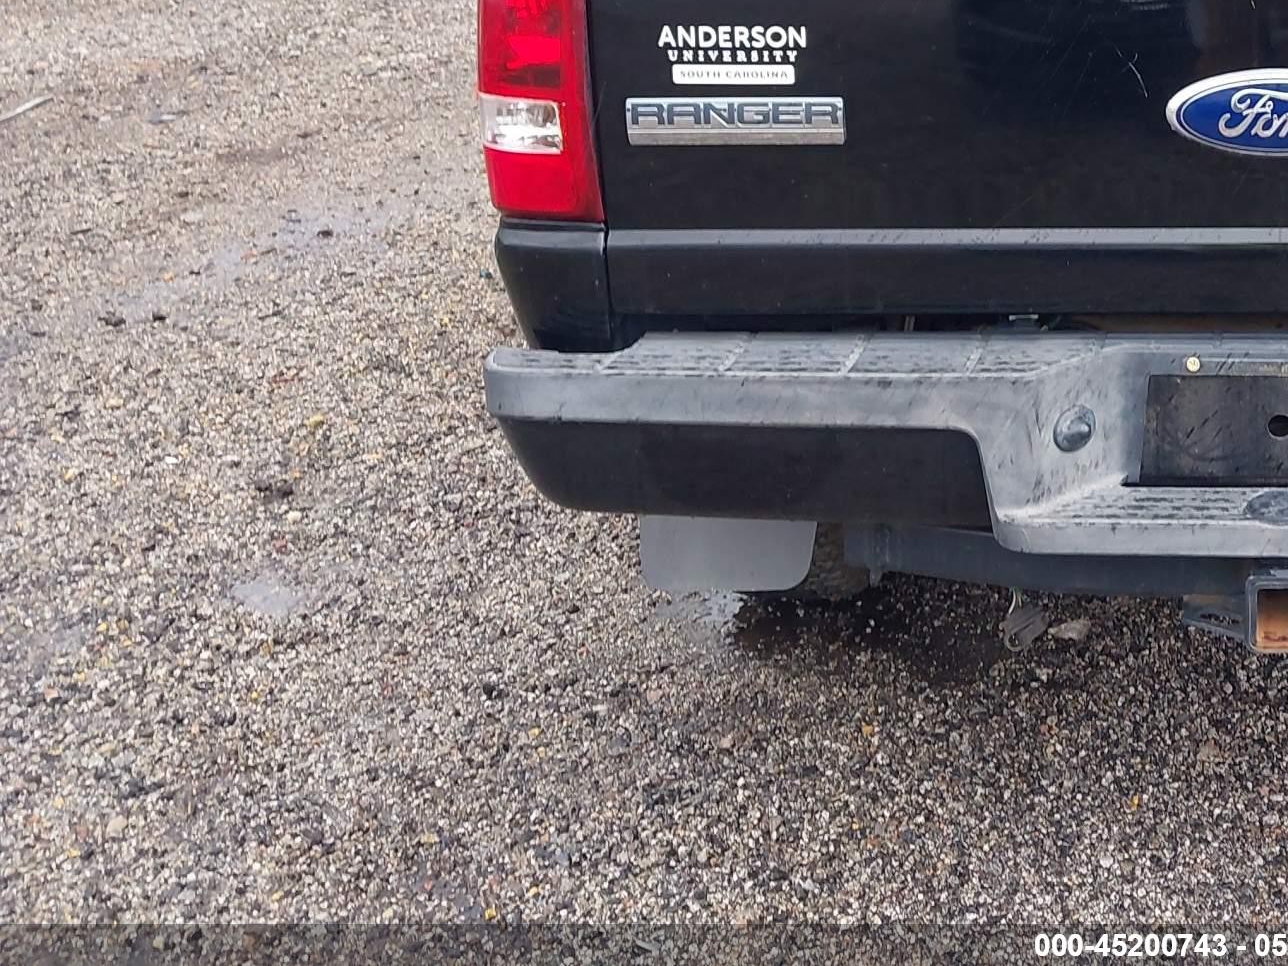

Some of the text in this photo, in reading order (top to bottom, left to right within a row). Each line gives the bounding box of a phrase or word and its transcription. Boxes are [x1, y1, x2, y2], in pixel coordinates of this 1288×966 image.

[657, 25, 807, 49] ANDERSON
[667, 50, 798, 62] UNIVERSITY
[679, 70, 788, 79] SOUTH CAROLINA
[629, 101, 840, 127] RANGER
